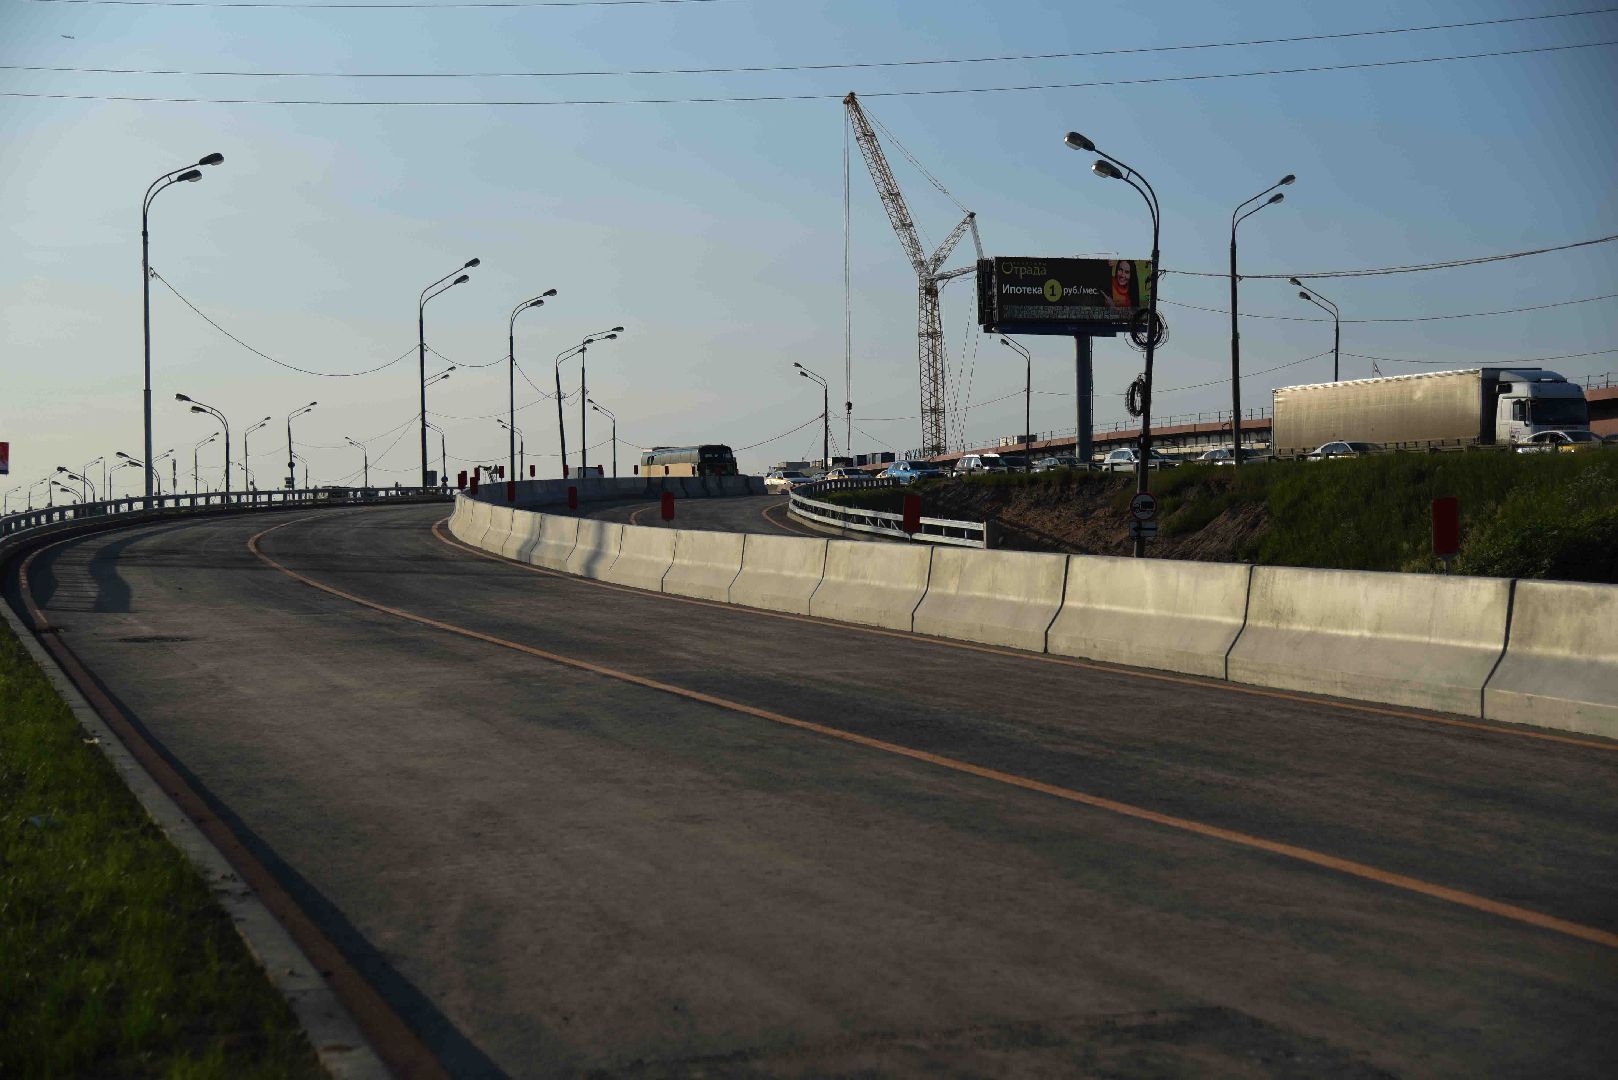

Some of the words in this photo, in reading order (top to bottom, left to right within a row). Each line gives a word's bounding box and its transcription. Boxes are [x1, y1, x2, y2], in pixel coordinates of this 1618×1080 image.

[1001, 261, 1047, 279] Отрада
[1002, 283, 1043, 295] Ипотека
[1050, 284, 1057, 297] 1
